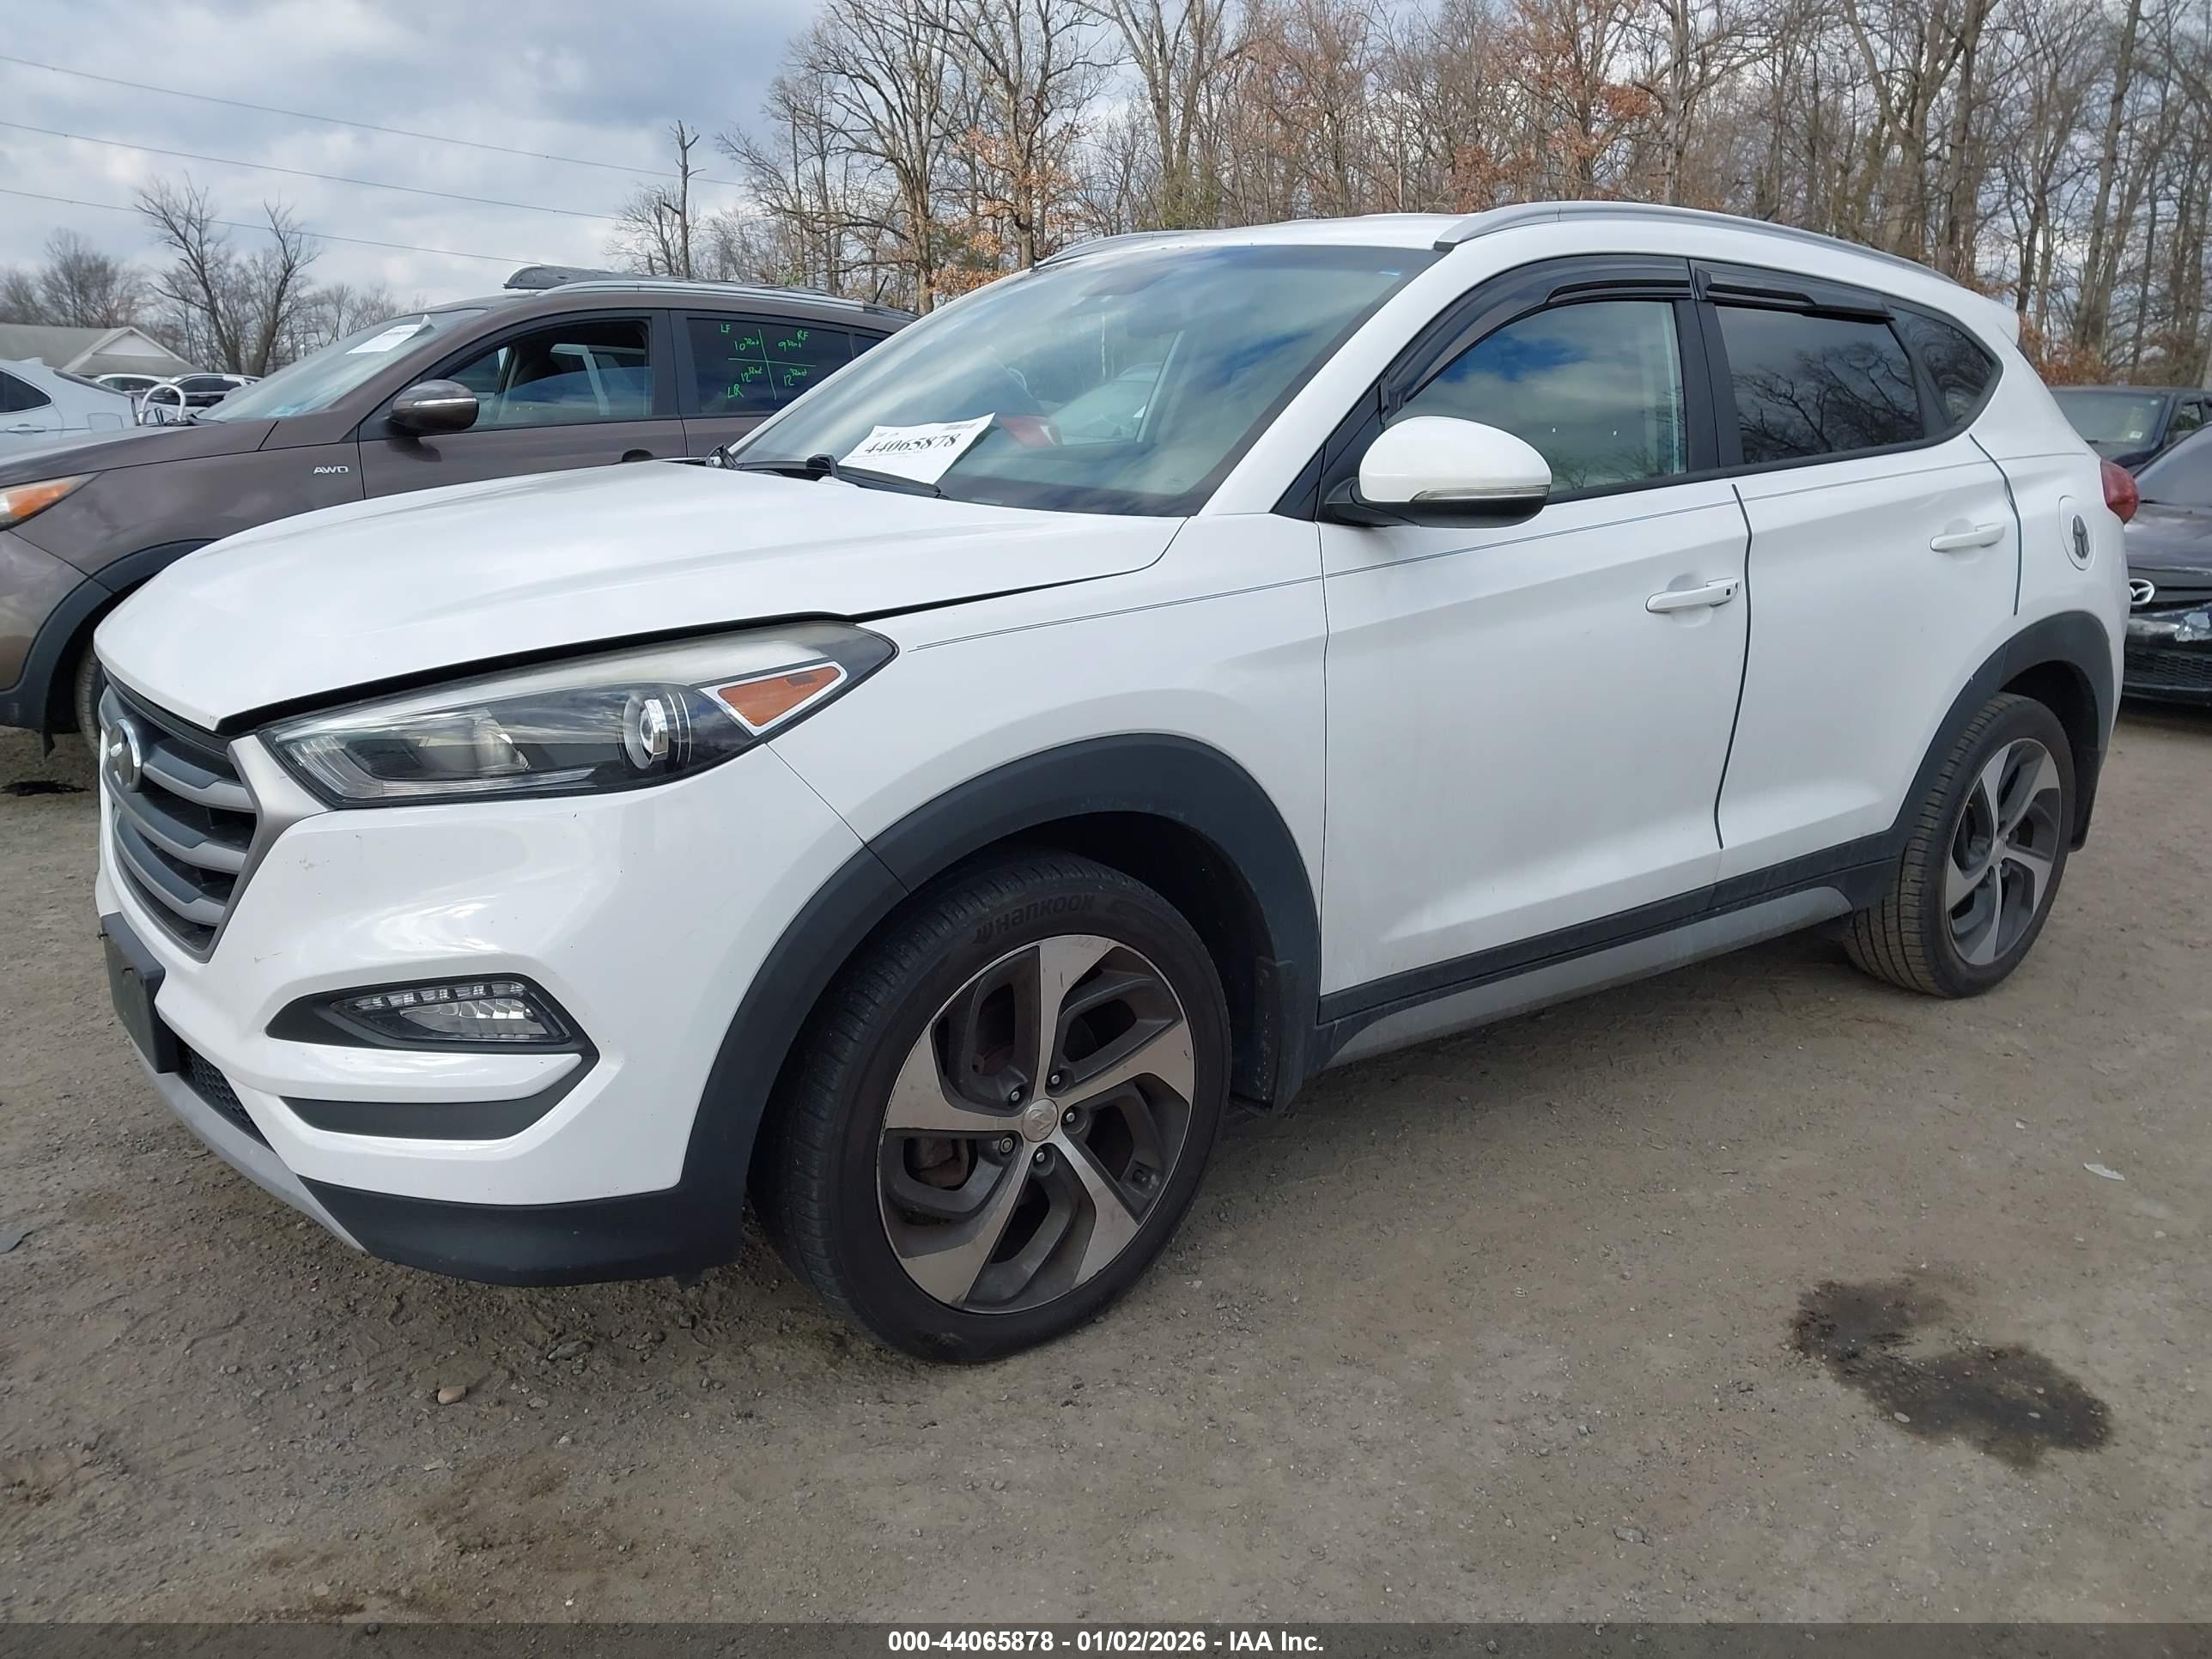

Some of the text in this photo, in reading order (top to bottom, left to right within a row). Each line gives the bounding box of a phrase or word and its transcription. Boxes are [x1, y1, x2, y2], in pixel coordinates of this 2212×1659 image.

[720, 324, 731, 333] LF
[797, 330, 809, 340] RF
[727, 383, 744, 399] LR
[864, 433, 961, 454] 44065878
[313, 465, 349, 475] AWD
